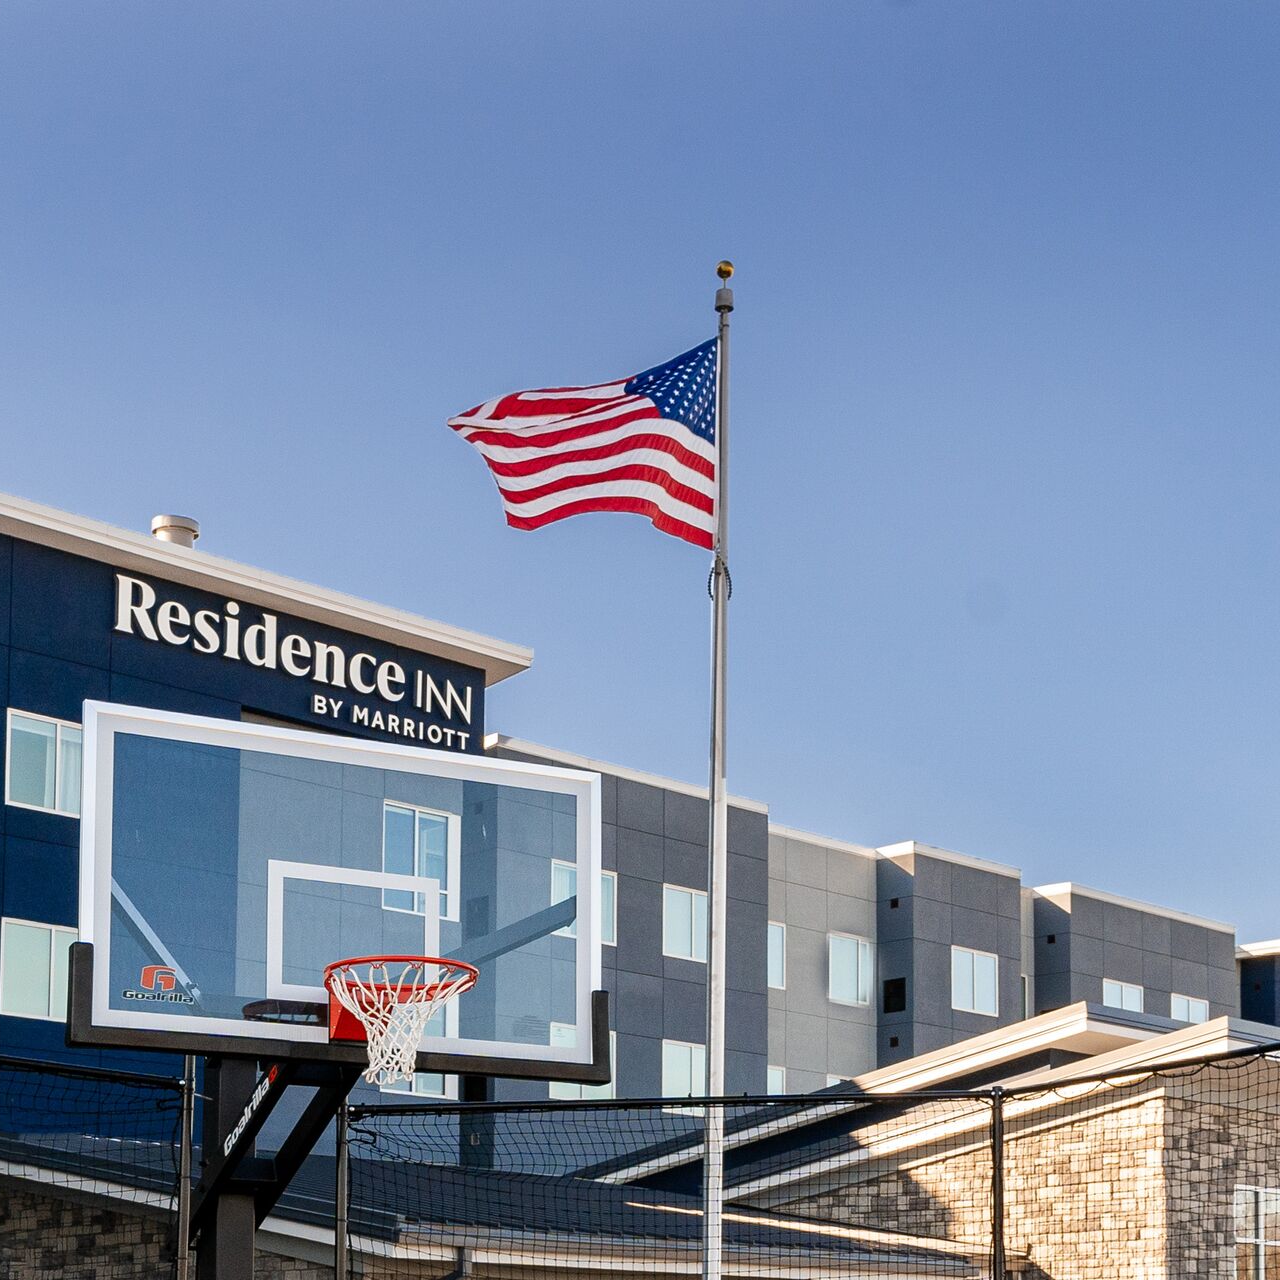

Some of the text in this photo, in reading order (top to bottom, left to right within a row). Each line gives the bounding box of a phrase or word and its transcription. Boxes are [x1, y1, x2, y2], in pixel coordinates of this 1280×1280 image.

[114, 573, 472, 726] Residence INN
[313, 694, 470, 750] BY MARRIOTT
[122, 989, 194, 1005] Goalrilla
[223, 1077, 270, 1157] Goalrilla
